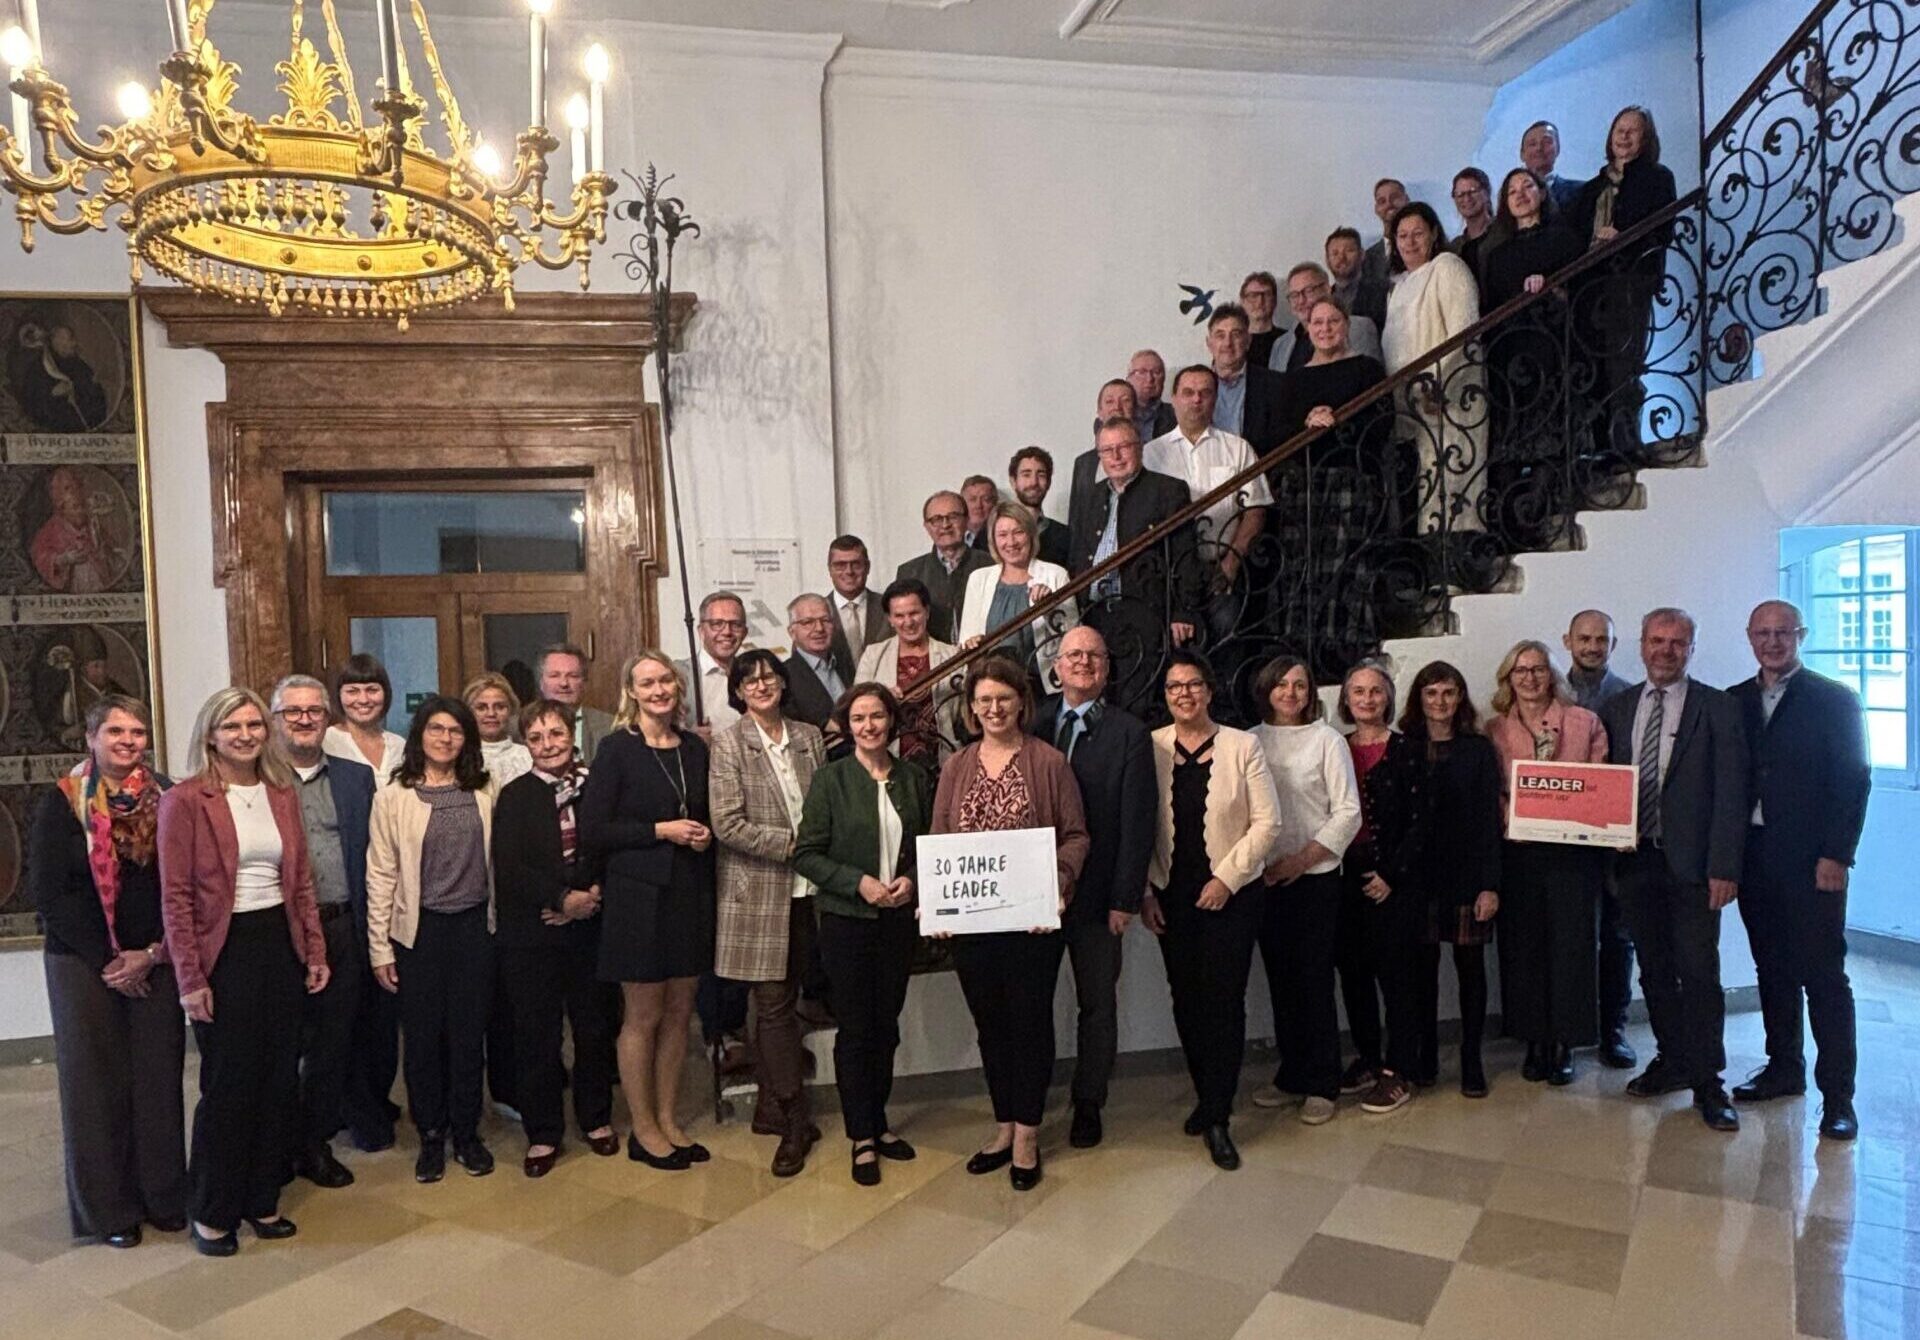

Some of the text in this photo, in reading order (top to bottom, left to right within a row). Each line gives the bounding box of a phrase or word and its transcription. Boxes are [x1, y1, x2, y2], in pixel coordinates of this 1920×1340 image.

[1519, 776, 1584, 791] LEADER
[934, 854, 1007, 875] 30 JAHRE
[942, 879, 1001, 899] LEADER
